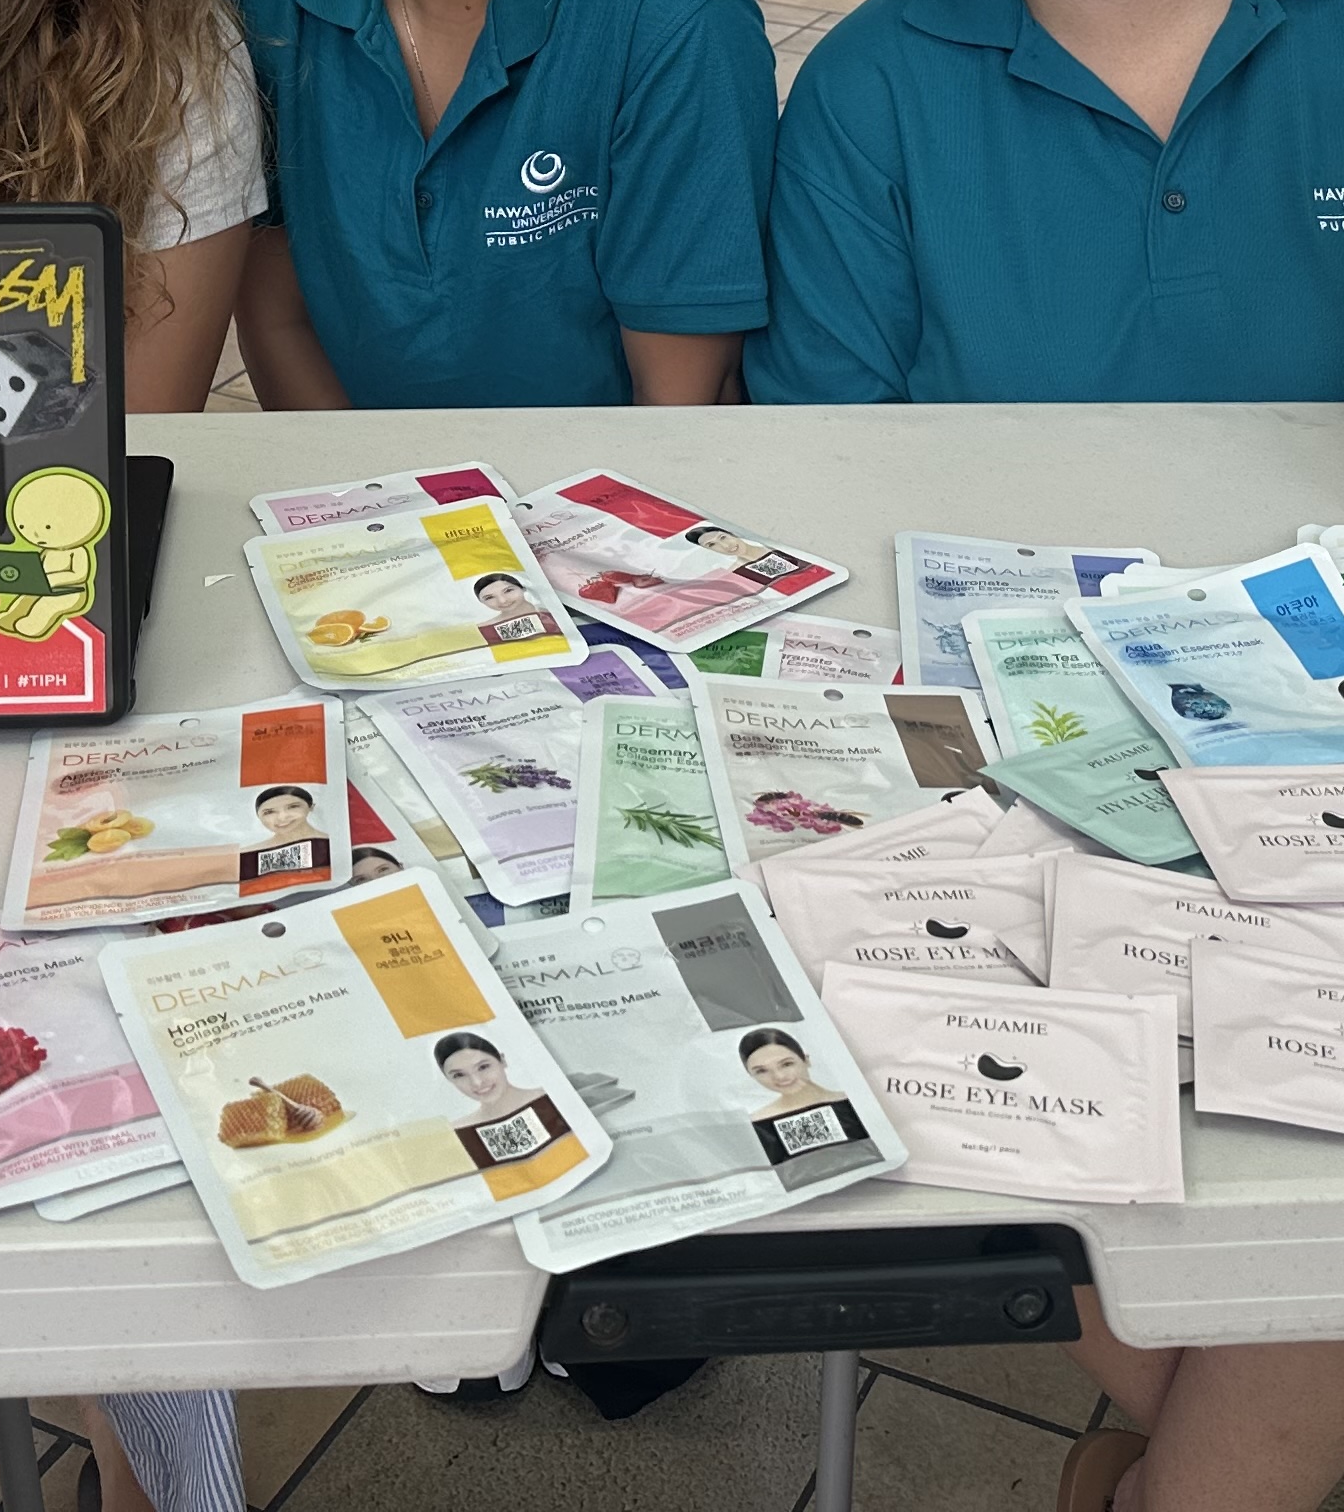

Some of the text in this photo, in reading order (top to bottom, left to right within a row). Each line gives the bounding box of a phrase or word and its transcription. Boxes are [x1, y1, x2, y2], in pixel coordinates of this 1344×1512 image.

[548, 186, 599, 210] PACIFIC
[511, 200, 575, 229] UNIVERSITY
[487, 212, 599, 248] PUBLIC HEALTH
[288, 501, 383, 527] DERMAL
[389, 552, 421, 564] Mask
[924, 558, 1030, 578] DERMAL
[285, 565, 340, 584] Vitamin
[1030, 587, 1060, 595] Mask
[1276, 595, 1320, 618] 아쿠아
[1109, 617, 1218, 641] DERMAL
[1125, 642, 1164, 656] Aqua
[1181, 638, 1265, 653] Essence Mask
[1055, 653, 1080, 663] Tea
[17, 674, 67, 687] #TIPH
[840, 667, 872, 679] Mask
[401, 689, 516, 718] DERMAL
[416, 713, 487, 730] Lavender
[421, 704, 564, 736] Collagen Essence Mask
[725, 709, 844, 730] DERMAL
[347, 731, 382, 745] Mask
[732, 741, 882, 755] Collagen Essence Mask
[764, 735, 819, 747] Venom
[63, 741, 189, 766] DERMAL
[617, 743, 697, 759] Rosemary
[1088, 743, 1153, 769] PEAUAMIE
[182, 758, 217, 769] Mask
[61, 768, 121, 783] Apricot
[1259, 834, 1320, 847] ROSE
[884, 889, 976, 901] PEAUAMIE
[1176, 900, 1271, 929] PEAUAMIE
[380, 930, 414, 944] 허니
[44, 955, 84, 970] Mask
[856, 946, 975, 961] ROSE EYE
[1124, 943, 1188, 969] ROSE
[152, 965, 298, 1013] DERMAL
[556, 989, 661, 1012] Essence Mask
[168, 1012, 228, 1039] Honey
[173, 986, 349, 1048] Collagen Essence Mask
[946, 1014, 1048, 1036] PEAUAMIE
[1268, 1035, 1336, 1061] ROSE
[886, 1077, 1105, 1117] ROSE EYE MASK
[32, 1131, 156, 1169] BEAUTIFUL HEALTHY
[564, 1189, 746, 1237] MAKES YOU BEAUTIFUL AND HEALTHY
[587, 1188, 721, 1223] CONFIDENCE WITH DERMAL
